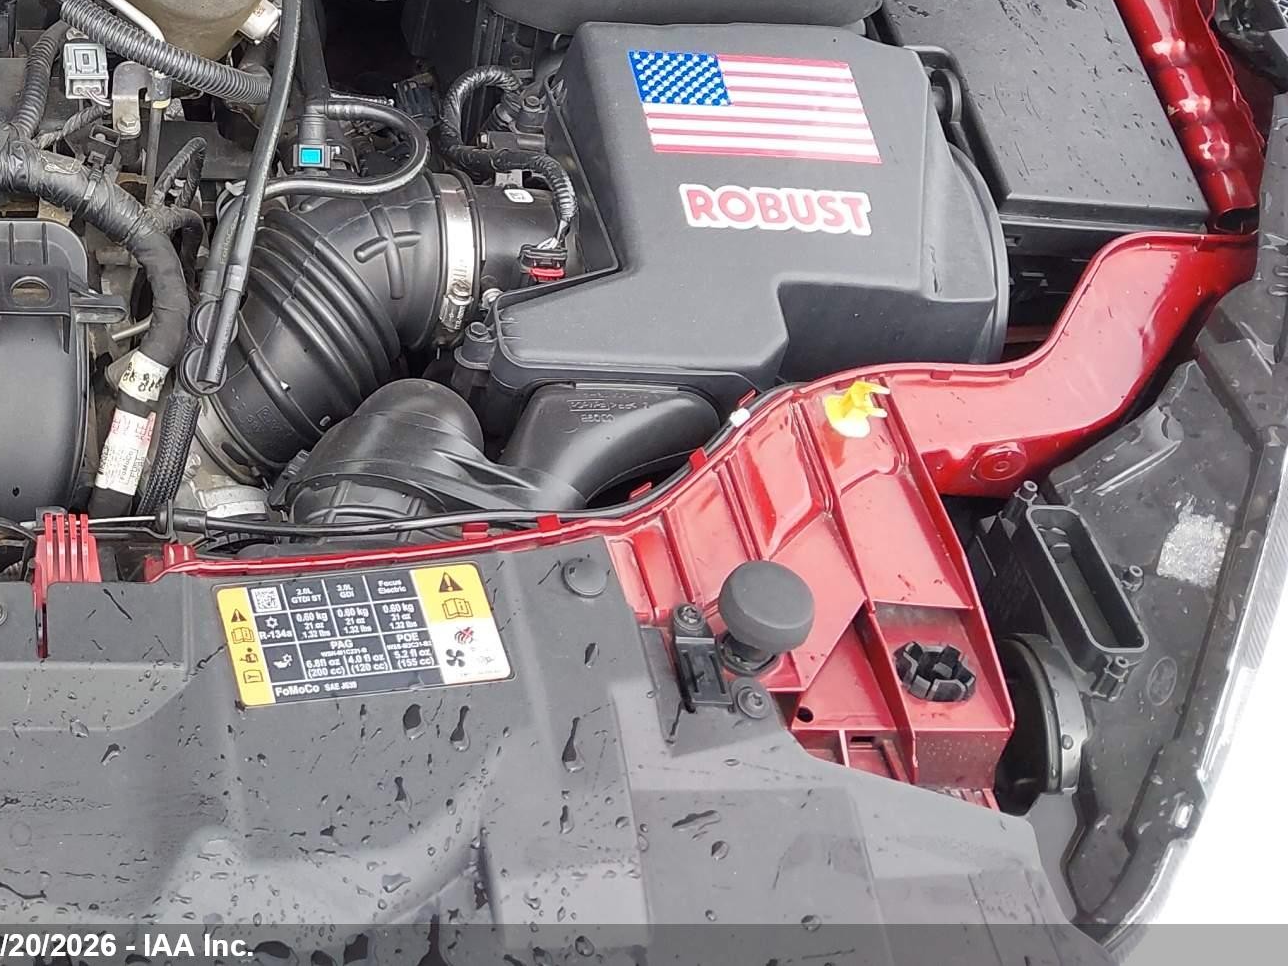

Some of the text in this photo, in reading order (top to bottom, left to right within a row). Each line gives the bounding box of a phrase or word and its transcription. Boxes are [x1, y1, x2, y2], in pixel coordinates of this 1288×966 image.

[685, 188, 864, 229] ROBUST
[356, 607, 369, 618] kg
[402, 603, 415, 613] kg
[316, 611, 328, 622] kg
[390, 613, 400, 621] 21
[319, 629, 331, 637] lbs
[360, 624, 372, 632] lbs
[259, 630, 292, 640] R-134a
[396, 633, 420, 642] POE
[329, 639, 354, 650] PAG
[348, 654, 362, 664] 4.0
[372, 653, 385, 661] oz
[393, 649, 409, 659] 5.2
[419, 648, 431, 656] oz
[328, 658, 342, 666] oz
[397, 657, 435, 669] (155 cc)
[307, 666, 345, 679] (200 cc)
[350, 662, 389, 674] (120 cc)
[275, 684, 320, 697] FoMoCo
[324, 683, 340, 691] SAE
